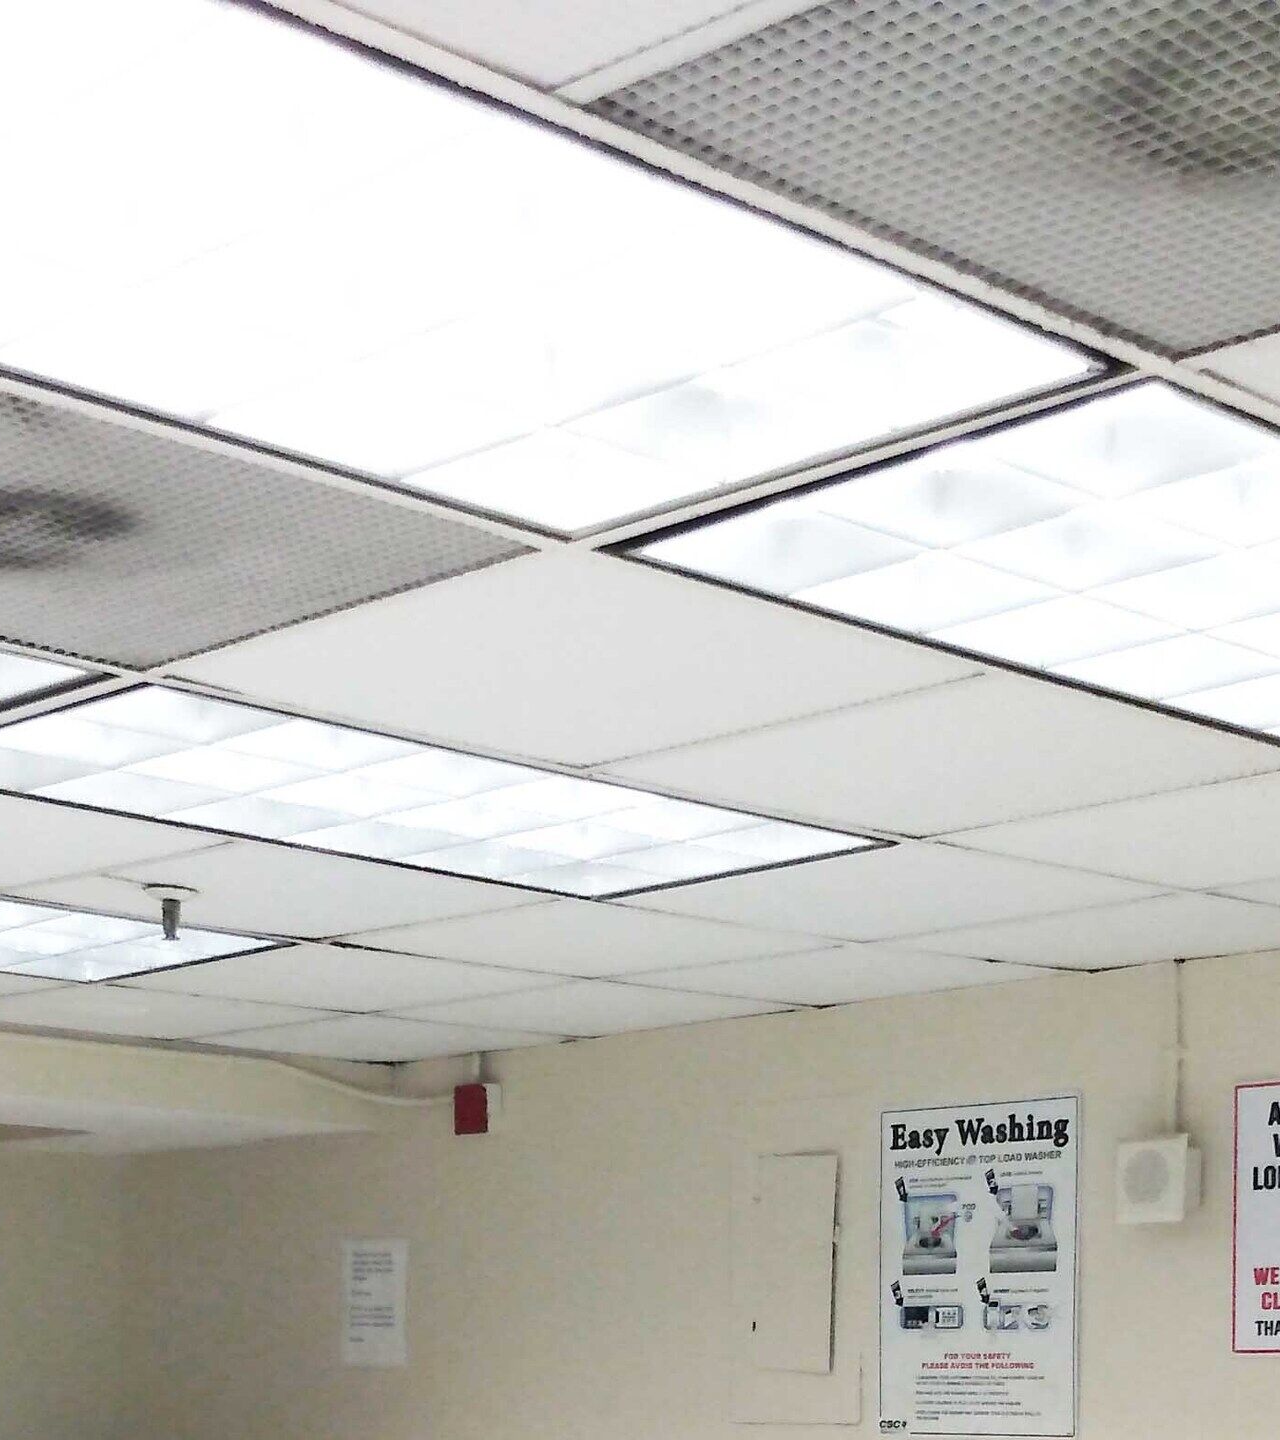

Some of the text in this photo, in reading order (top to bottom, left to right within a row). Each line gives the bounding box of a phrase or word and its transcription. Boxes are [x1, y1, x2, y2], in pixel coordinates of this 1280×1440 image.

[890, 1114, 1069, 1156] Easy Washing
[979, 1155, 996, 1163] TOP
[998, 1153, 1021, 1162] LOAD
[1024, 1151, 1062, 1161] WASHER
[1254, 1267, 1279, 1285] WE
[879, 1420, 900, 1428] CSC
